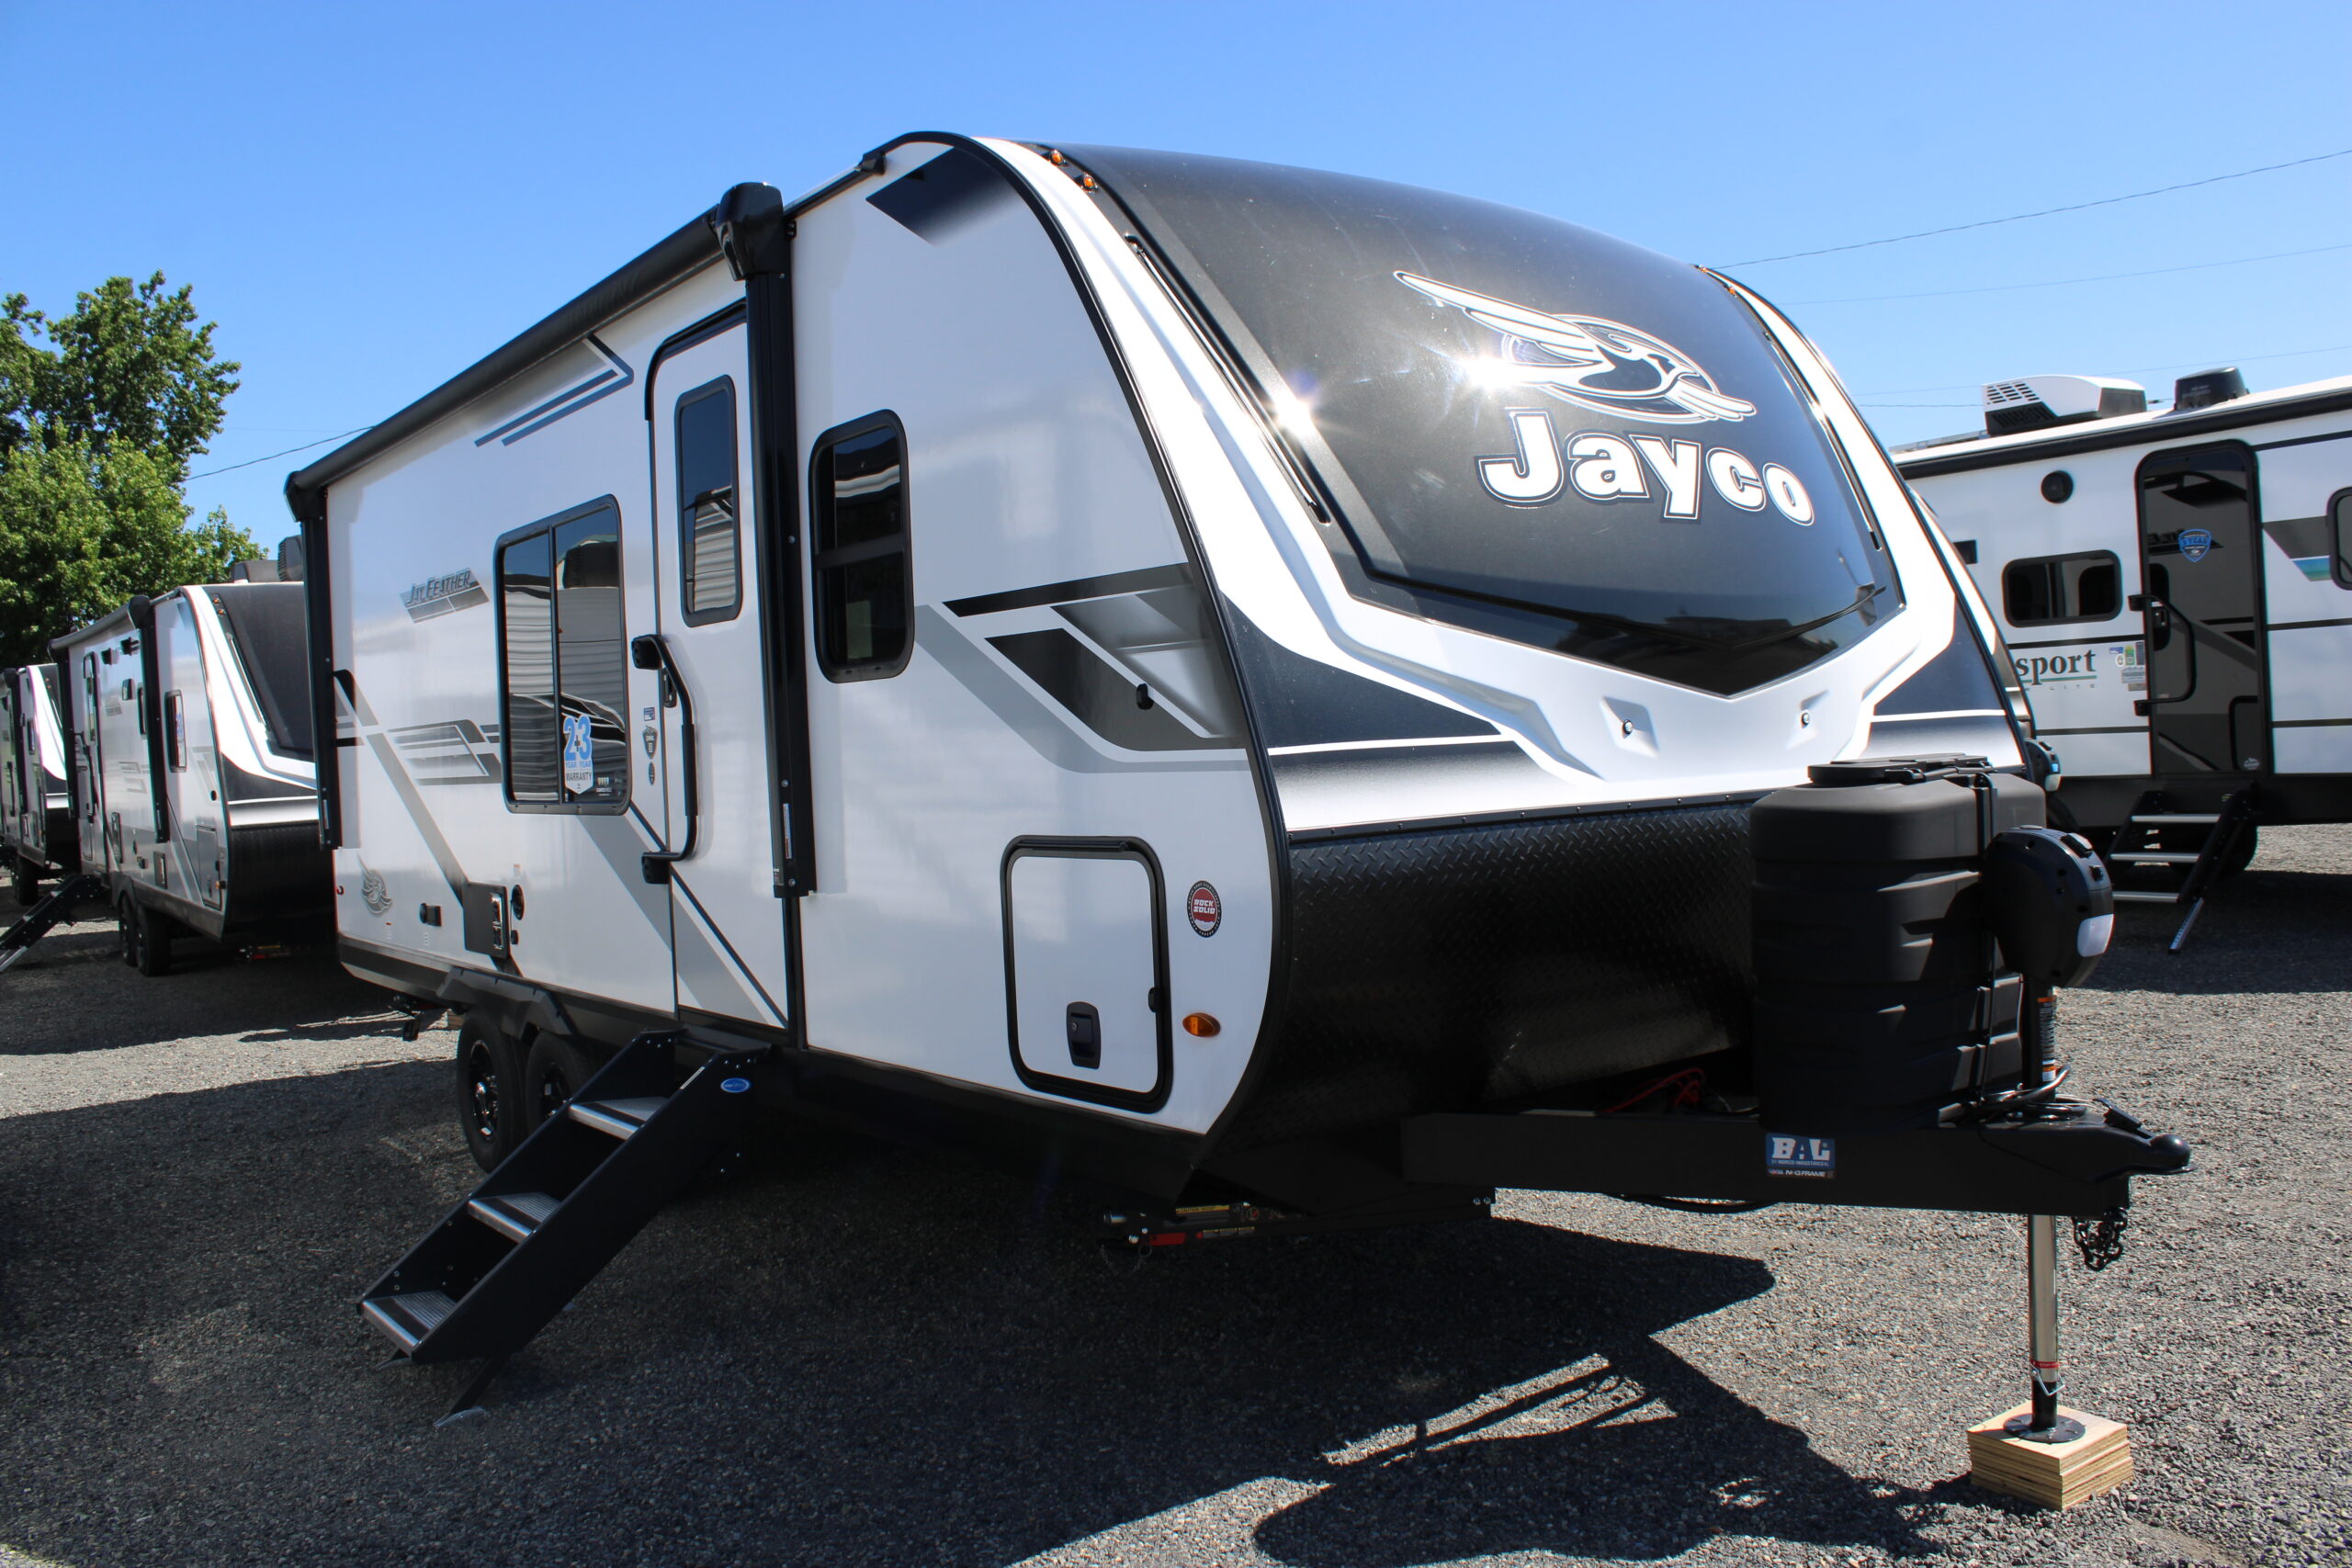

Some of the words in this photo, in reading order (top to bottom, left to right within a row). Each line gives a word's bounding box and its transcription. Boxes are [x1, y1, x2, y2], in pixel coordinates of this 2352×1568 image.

[1477, 410, 1815, 525] Jayco
[426, 569, 471, 598] FEATHER
[566, 773, 592, 781] WARRANTY
[1193, 899, 1214, 908] ROCK
[1193, 906, 1216, 914] SOLID
[1772, 1137, 1830, 1161] BAL
